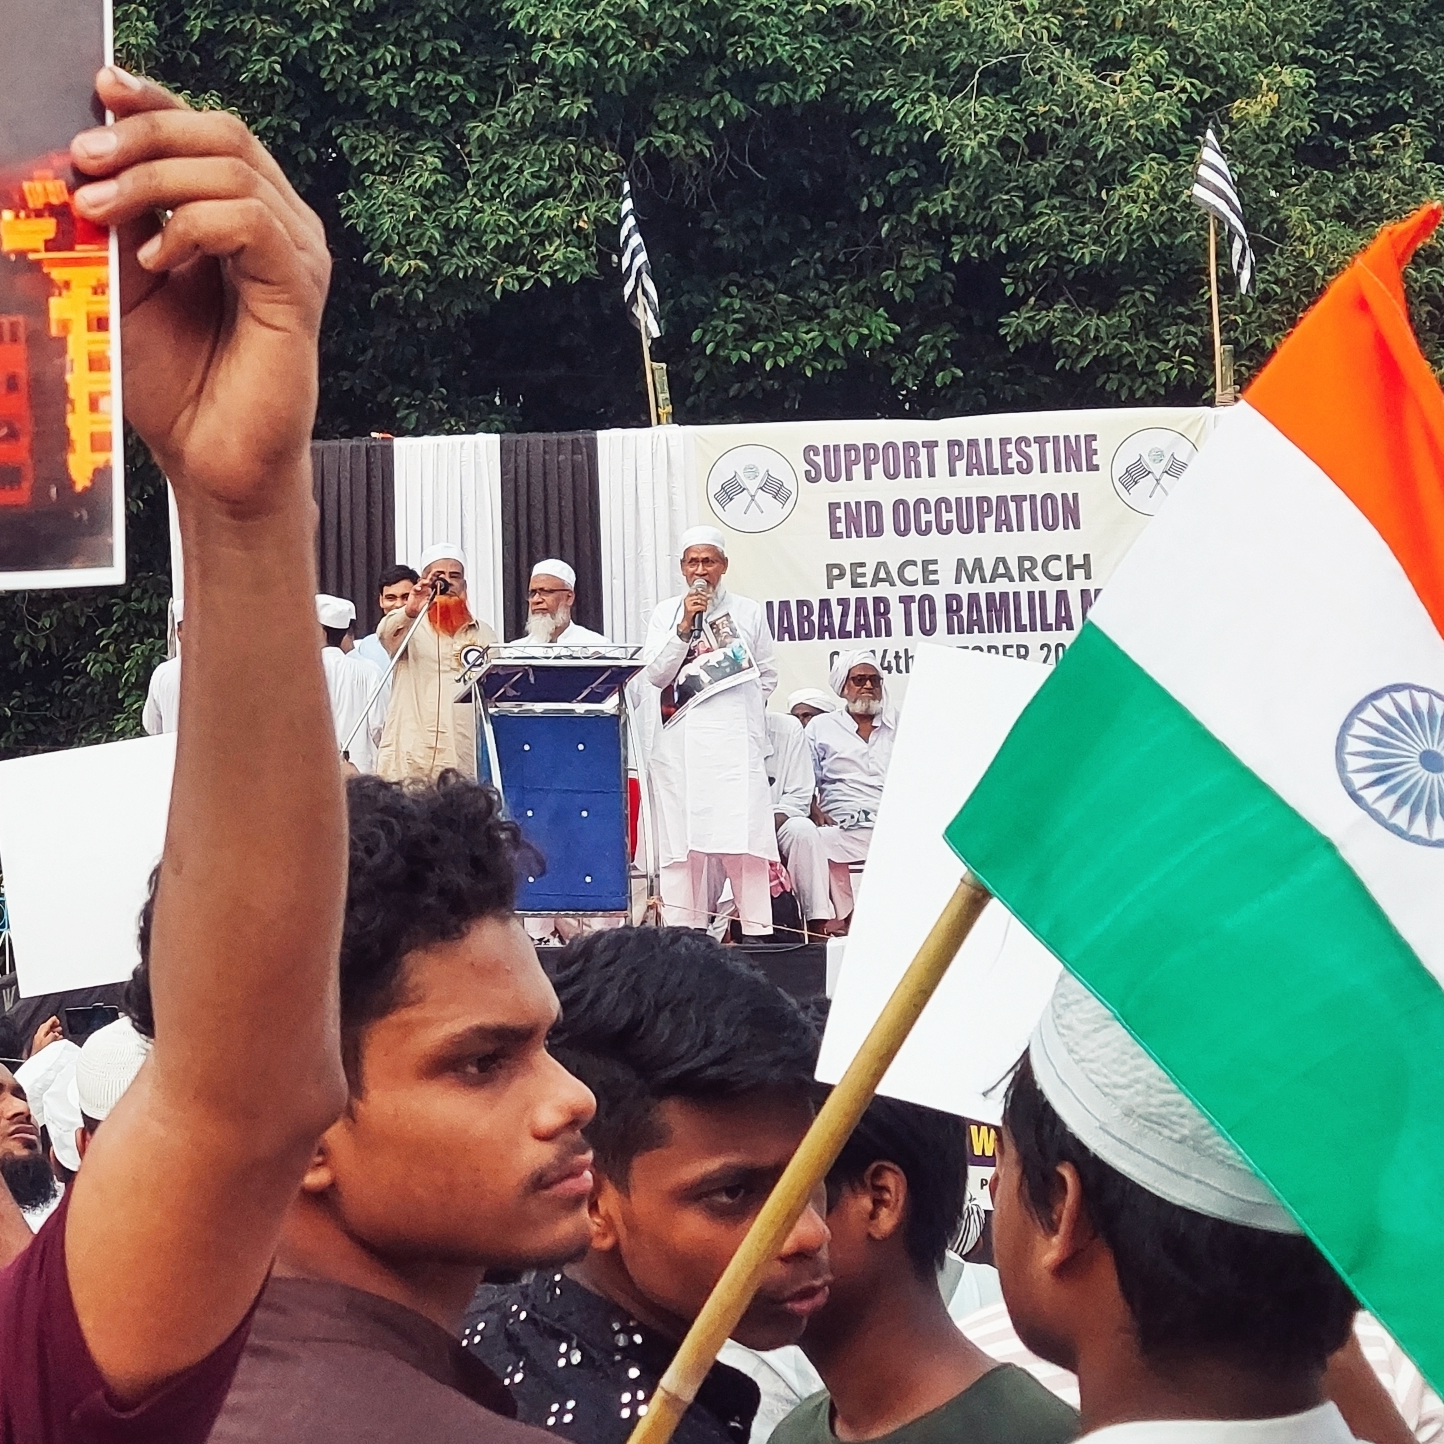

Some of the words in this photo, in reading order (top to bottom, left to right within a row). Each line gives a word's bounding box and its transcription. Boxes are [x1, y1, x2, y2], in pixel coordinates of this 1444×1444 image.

[803, 440, 939, 483] SUPPORT
[947, 434, 1100, 477] PALESTINE
[828, 501, 885, 539] END
[892, 492, 1081, 537] OCCUPATION
[825, 559, 940, 590] PEACE
[954, 553, 1093, 584] MARCH
[899, 593, 937, 637] TO
[945, 590, 1074, 635] RAMLILA
